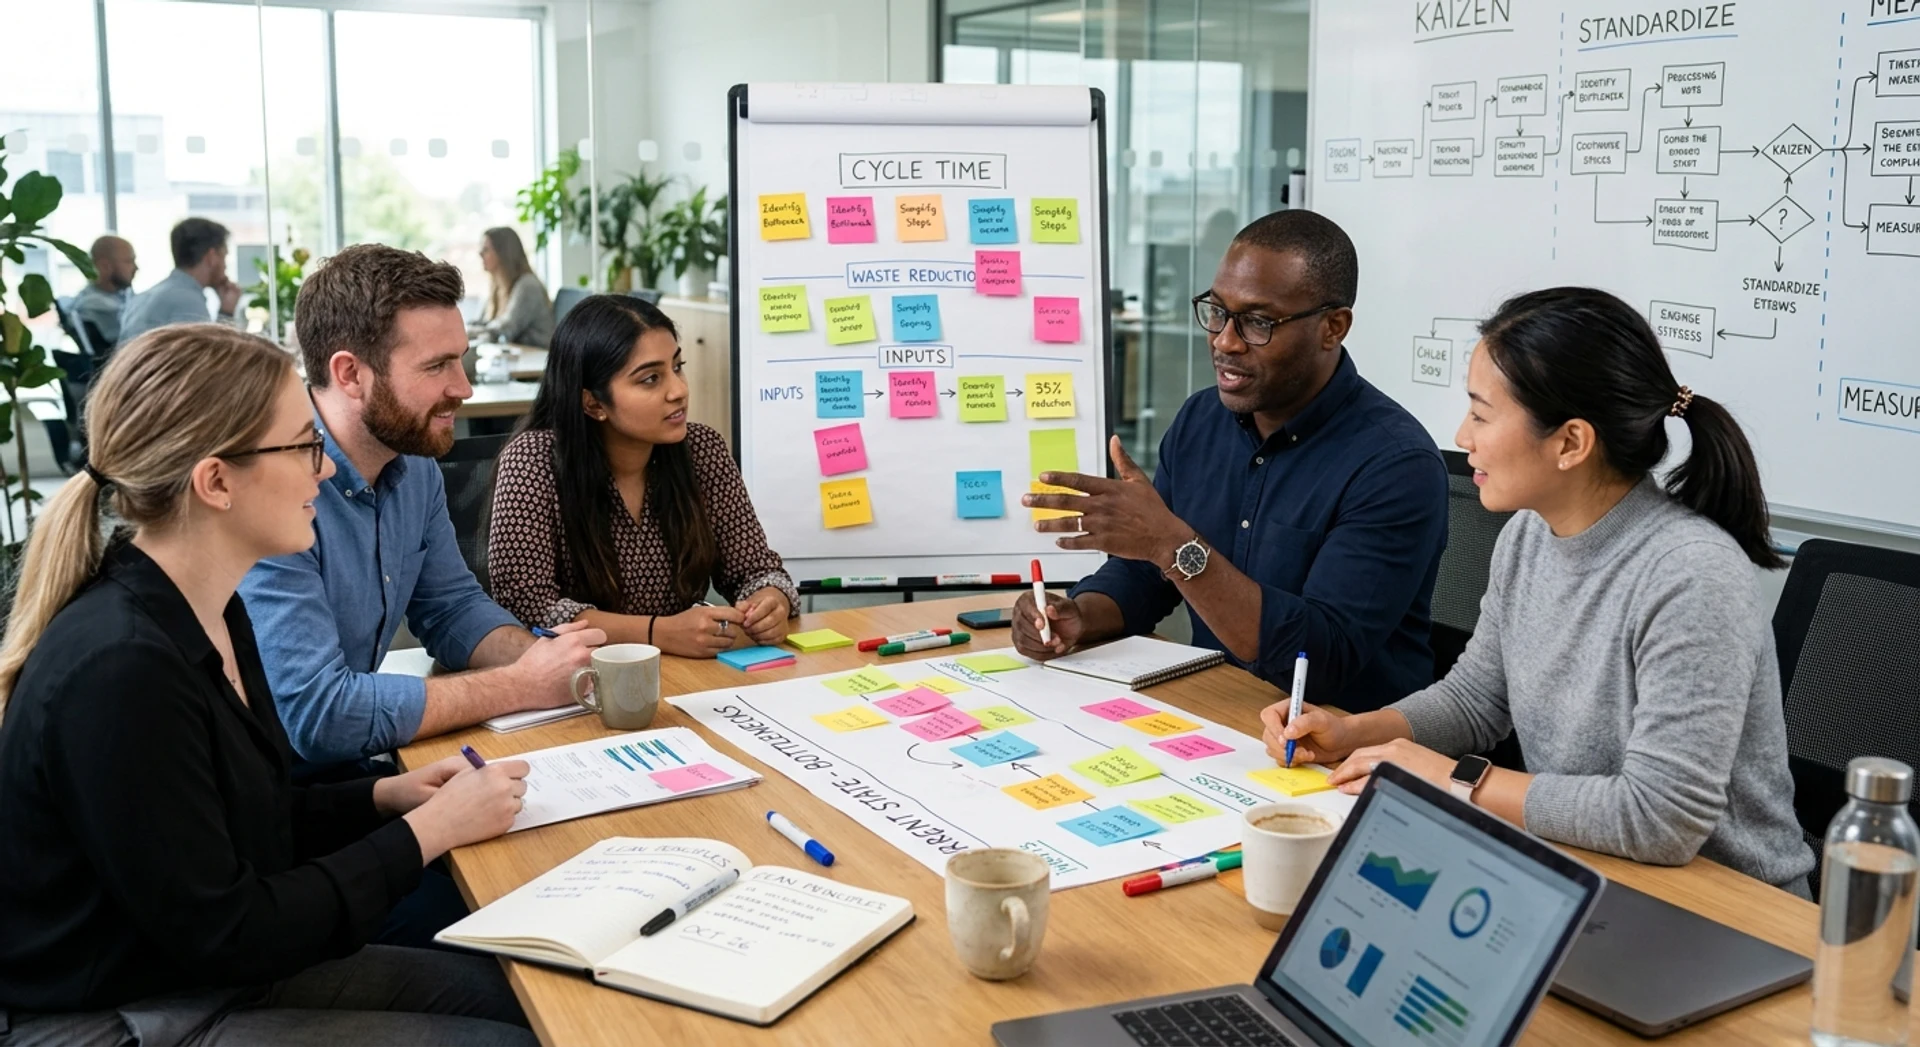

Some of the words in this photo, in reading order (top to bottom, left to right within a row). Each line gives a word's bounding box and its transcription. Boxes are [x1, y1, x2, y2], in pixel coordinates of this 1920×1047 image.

[1416, 0, 1510, 34] KAIZEN
[1579, 3, 1737, 44] STANDARDIZE
[1773, 144, 1812, 155] KAIZEN
[1883, 143, 1899, 153] THE
[852, 160, 922, 181] CYCLE
[935, 160, 992, 181] TIME
[907, 218, 932, 229] Steps
[1040, 221, 1067, 231] Steps
[1778, 208, 1789, 231] ?
[852, 268, 901, 283] WASTE
[909, 268, 977, 283] REDUCTIO
[1742, 277, 1820, 297] STANDARDIZE
[886, 349, 947, 364] INPUTS
[759, 386, 804, 402] INPUTS
[1036, 381, 1062, 395] 35%
[1031, 399, 1072, 409] reduction
[713, 704, 833, 770] BOTTLENECKS
[831, 777, 900, 811] STATE
[886, 814, 968, 855] RRENT
